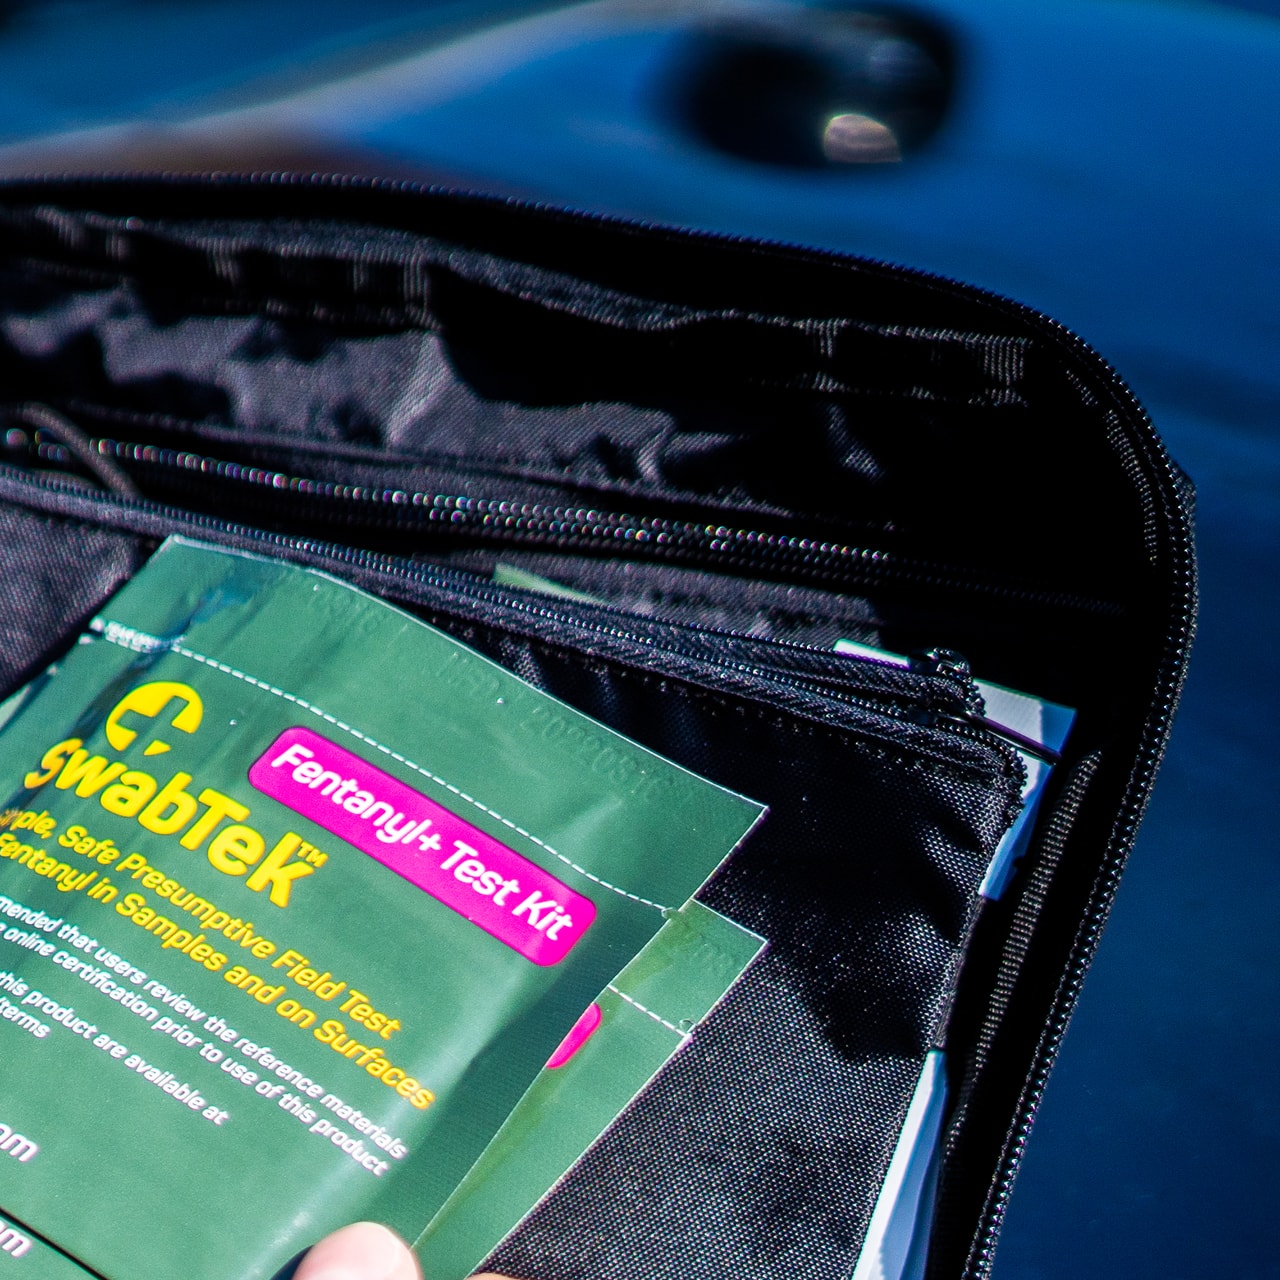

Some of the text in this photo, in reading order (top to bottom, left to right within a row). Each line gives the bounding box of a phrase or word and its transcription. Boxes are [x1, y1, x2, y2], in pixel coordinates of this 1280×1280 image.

[58, 825, 120, 865] Safe
[115, 853, 277, 960] Presumptive
[271, 949, 348, 1002] Field
[338, 989, 402, 1041] Test
[271, 743, 573, 941] Fentanyl+ Test Kit
[3, 929, 56, 957] online
[52, 951, 160, 1022] certification
[150, 1016, 203, 1048] prior
[199, 1042, 224, 1063] to
[220, 1057, 259, 1086] use
[254, 1080, 287, 1106] of
[278, 1093, 318, 1125] this
[308, 1118, 390, 1177] product
[20, 991, 98, 1040] product
[92, 1034, 129, 1059] are
[123, 1054, 207, 1111] available
[201, 1105, 230, 1126] at
[57, 924, 99, 953] that
[93, 947, 148, 983] users
[142, 980, 207, 1022] review
[203, 1016, 239, 1043] the
[233, 1038, 325, 1099] reference
[319, 1093, 408, 1160] materials
[87, 877, 119, 904] in
[115, 893, 229, 972] Samples
[223, 965, 287, 1005] and
[275, 999, 318, 1030] on
[313, 1019, 437, 1111] Surfaces
